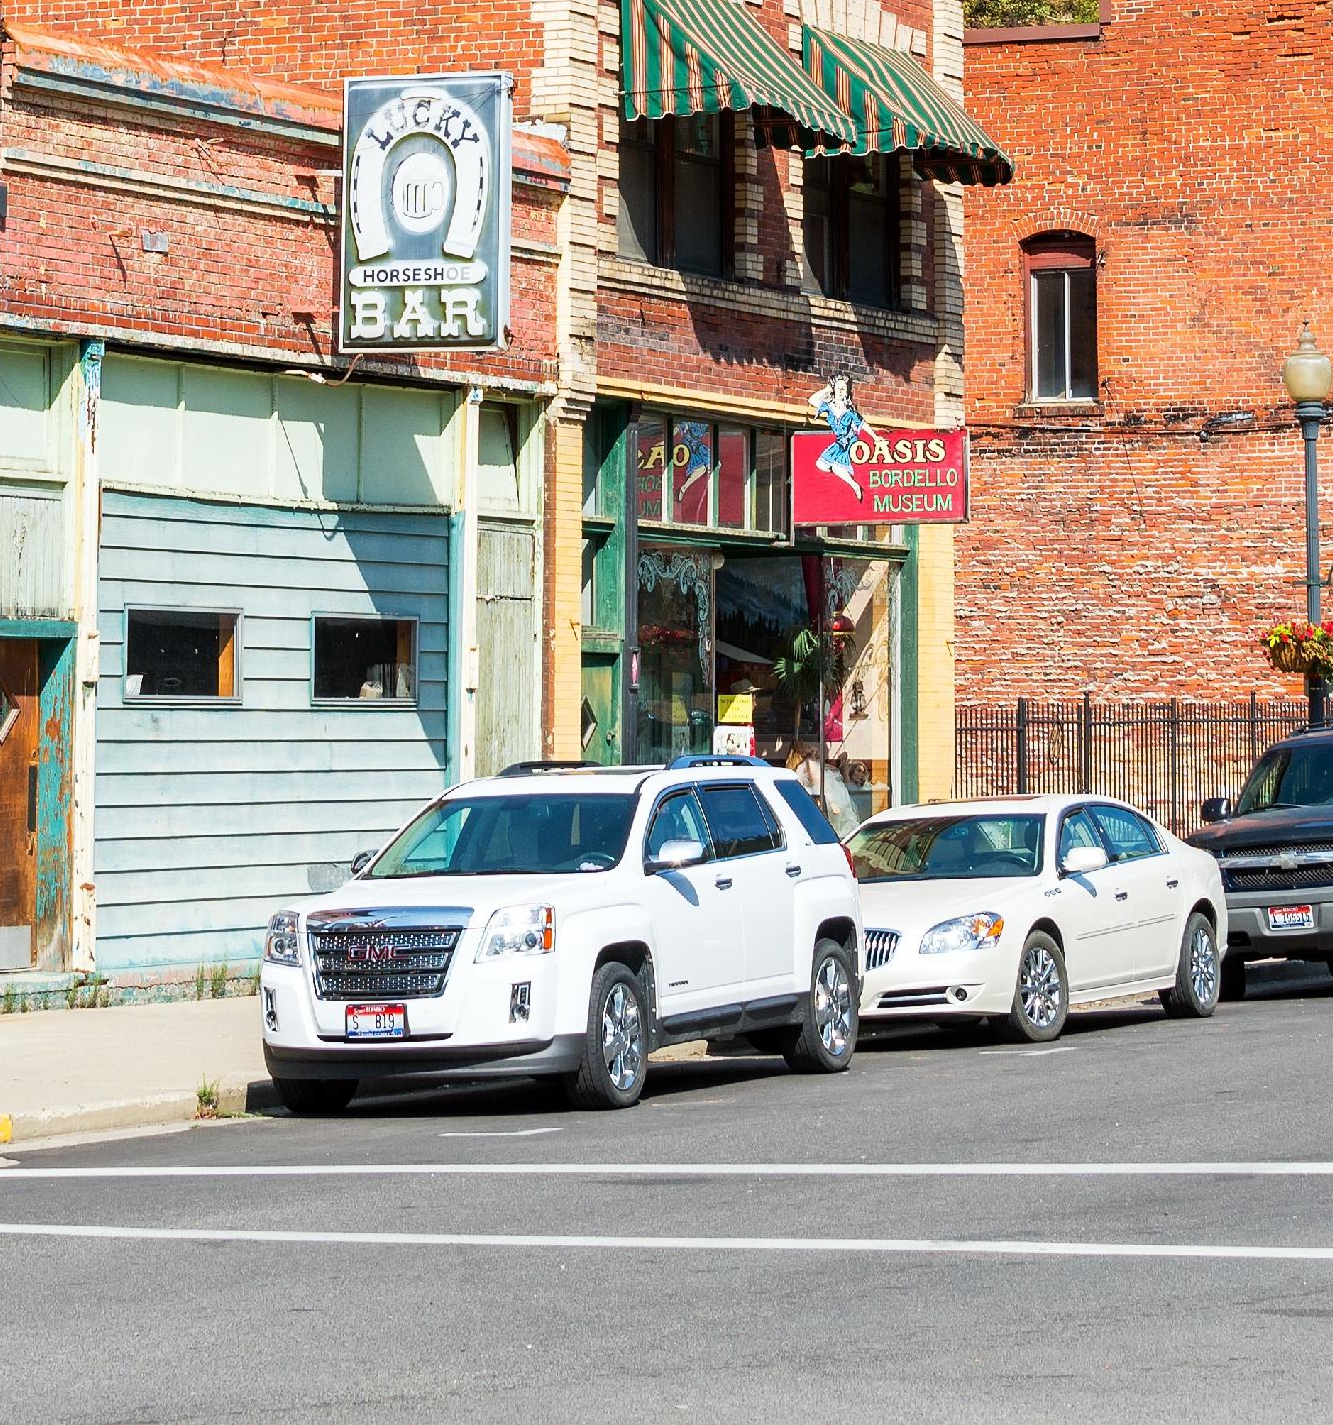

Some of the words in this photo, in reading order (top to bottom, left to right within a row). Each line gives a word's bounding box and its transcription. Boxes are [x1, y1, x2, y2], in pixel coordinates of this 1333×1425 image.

[365, 99, 480, 150] LUCKY
[362, 267, 471, 284] HORSESHOE
[350, 288, 487, 340] BAR
[849, 438, 947, 465] OASIS
[869, 468, 958, 488] BORDELLO
[873, 493, 953, 513] MUSEUM
[348, 943, 411, 961] GMC
[352, 1014, 359, 1030] S
